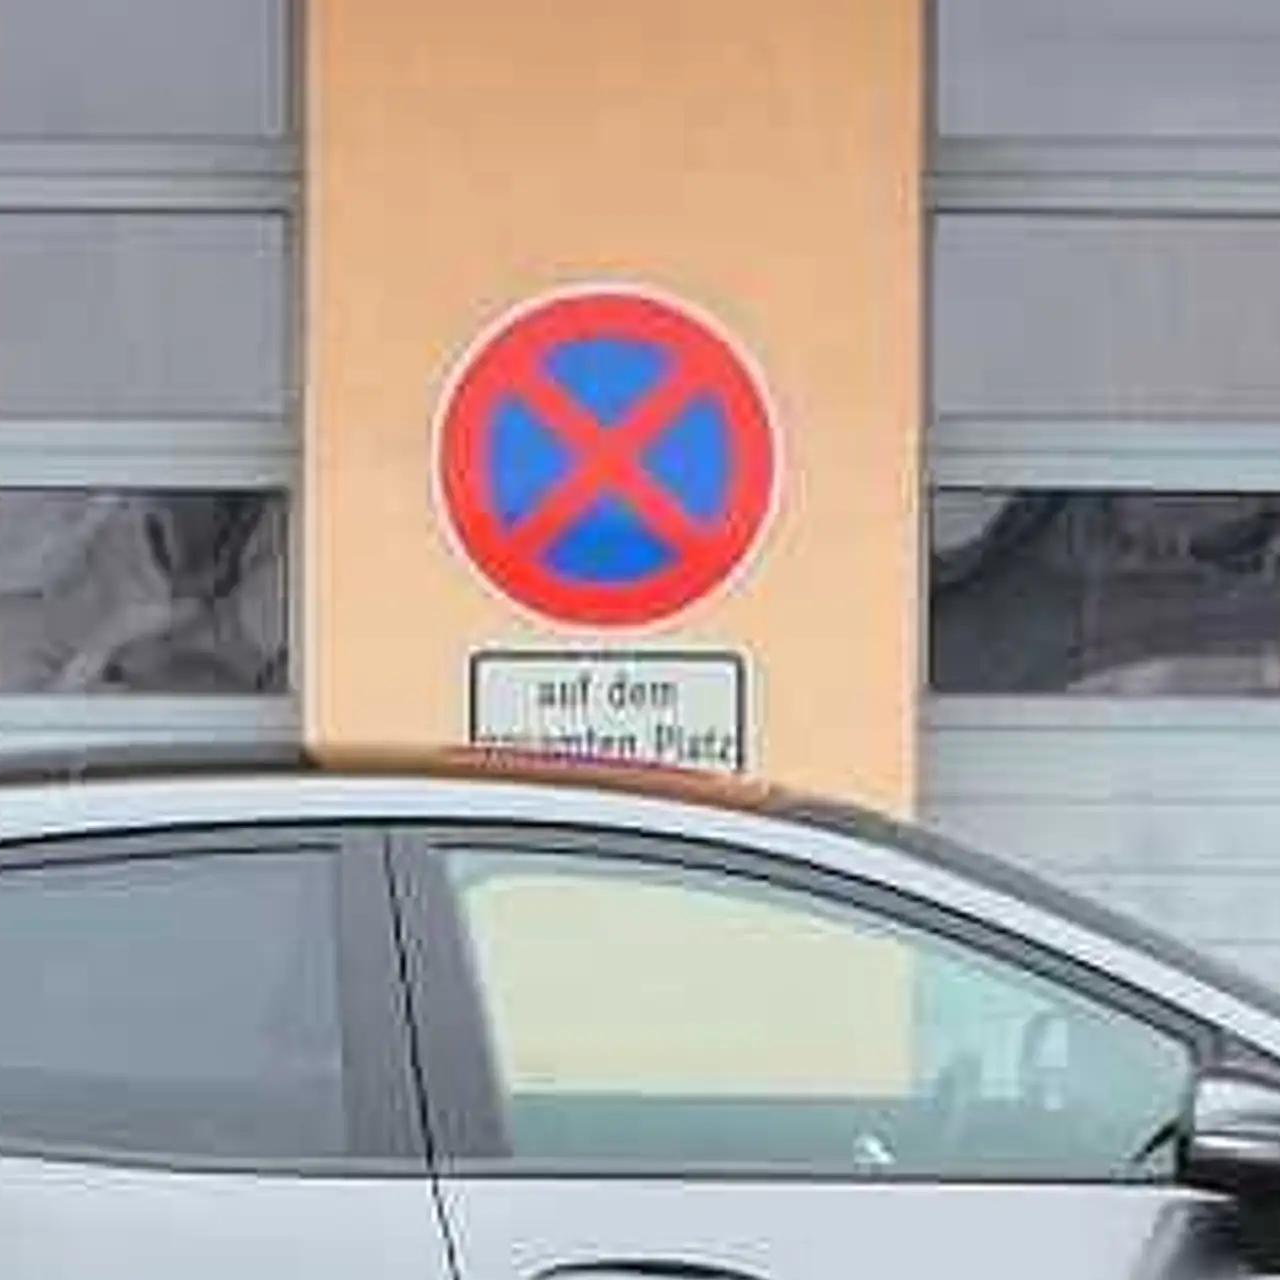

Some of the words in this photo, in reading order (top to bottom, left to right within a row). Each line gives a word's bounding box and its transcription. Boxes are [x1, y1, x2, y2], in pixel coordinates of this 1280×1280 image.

[536, 671, 593, 706] auf
[606, 671, 679, 707] dem
[655, 723, 735, 762] Platz
